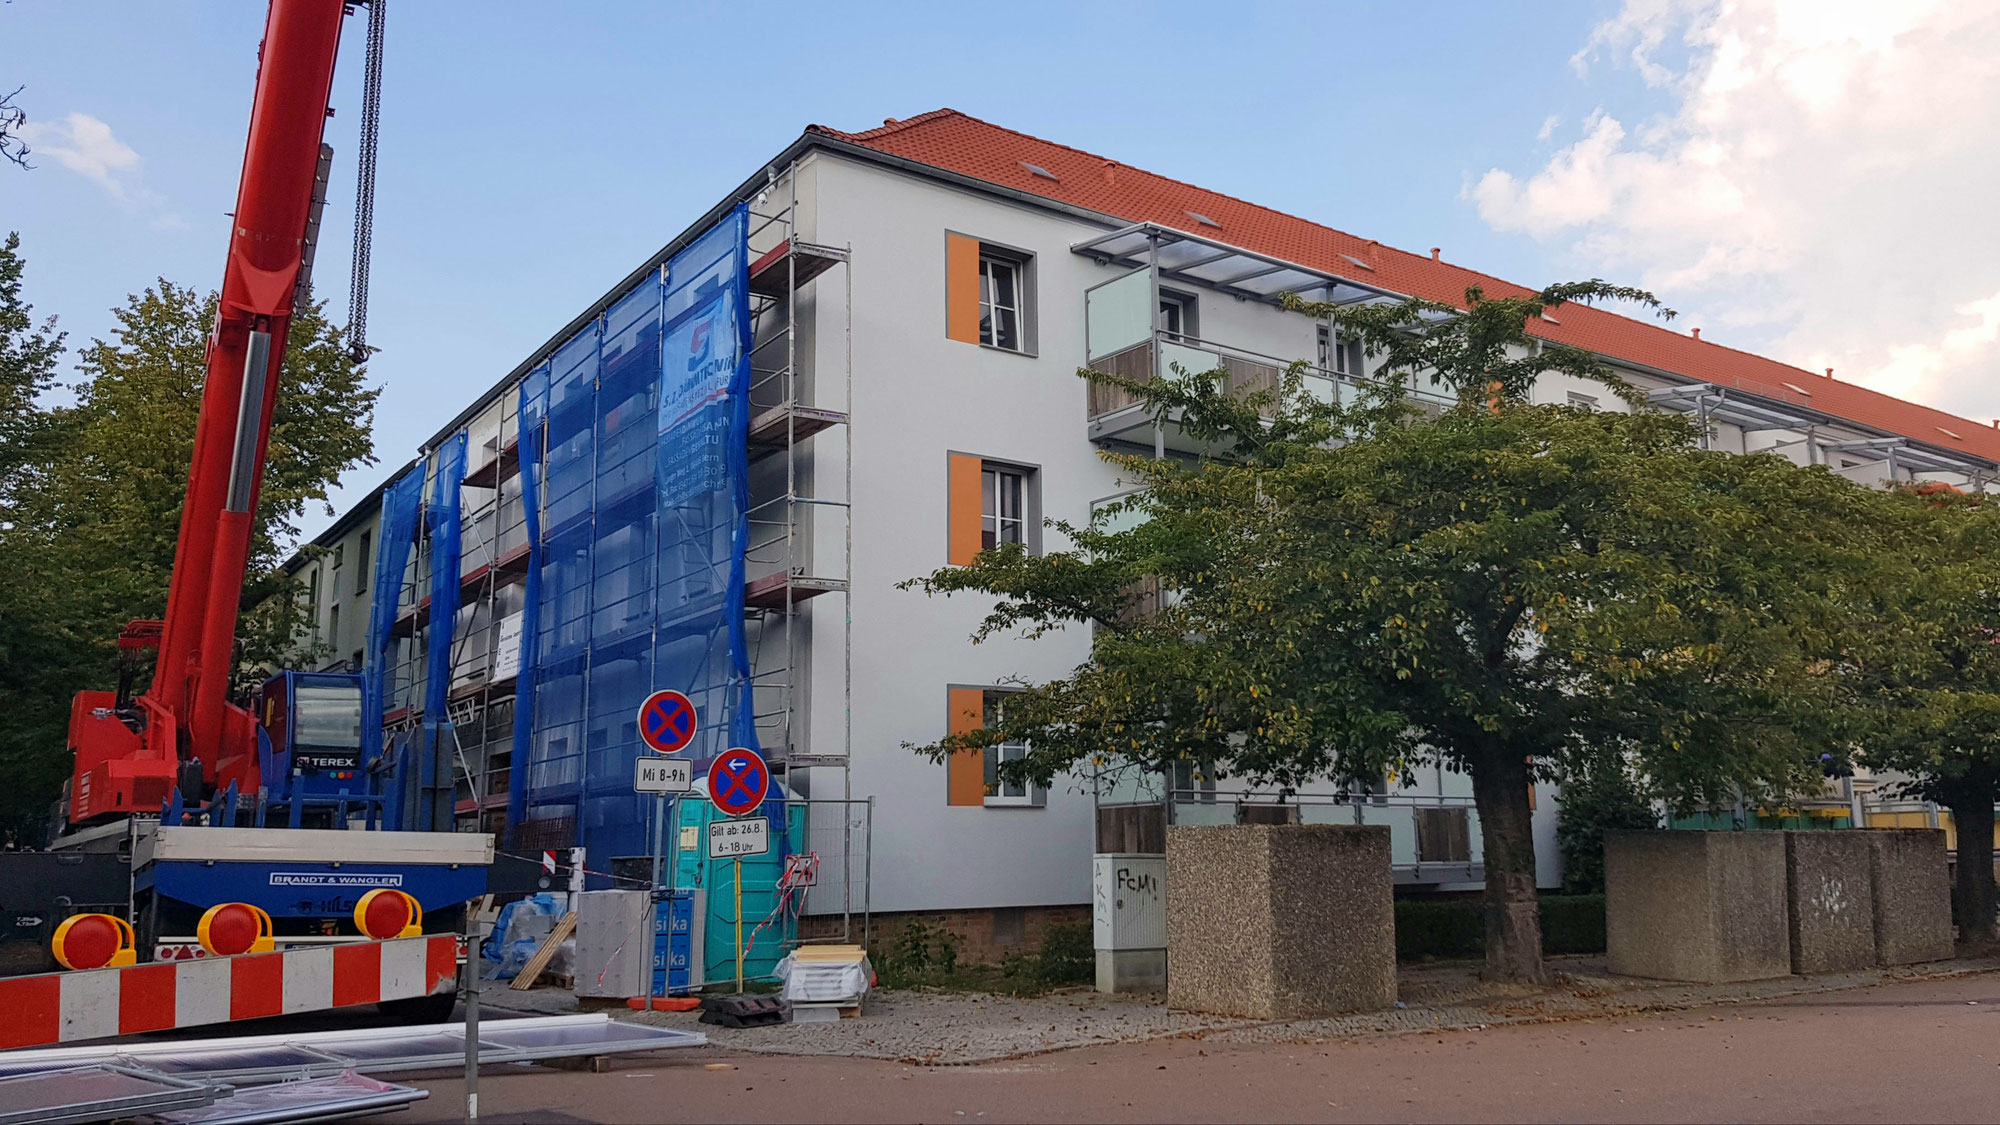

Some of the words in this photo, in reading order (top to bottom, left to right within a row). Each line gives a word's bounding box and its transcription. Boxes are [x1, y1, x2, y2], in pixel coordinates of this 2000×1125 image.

[311, 757, 354, 767] TEREX
[643, 768, 655, 782] Mi
[711, 826, 724, 837] Gilt
[727, 824, 739, 836] ab:
[741, 823, 763, 834] 26.8.
[742, 843, 754, 852] Uhr
[274, 876, 325, 885] BRANDT
[339, 877, 398, 886] WANGLER
[320, 896, 357, 913] HILS
